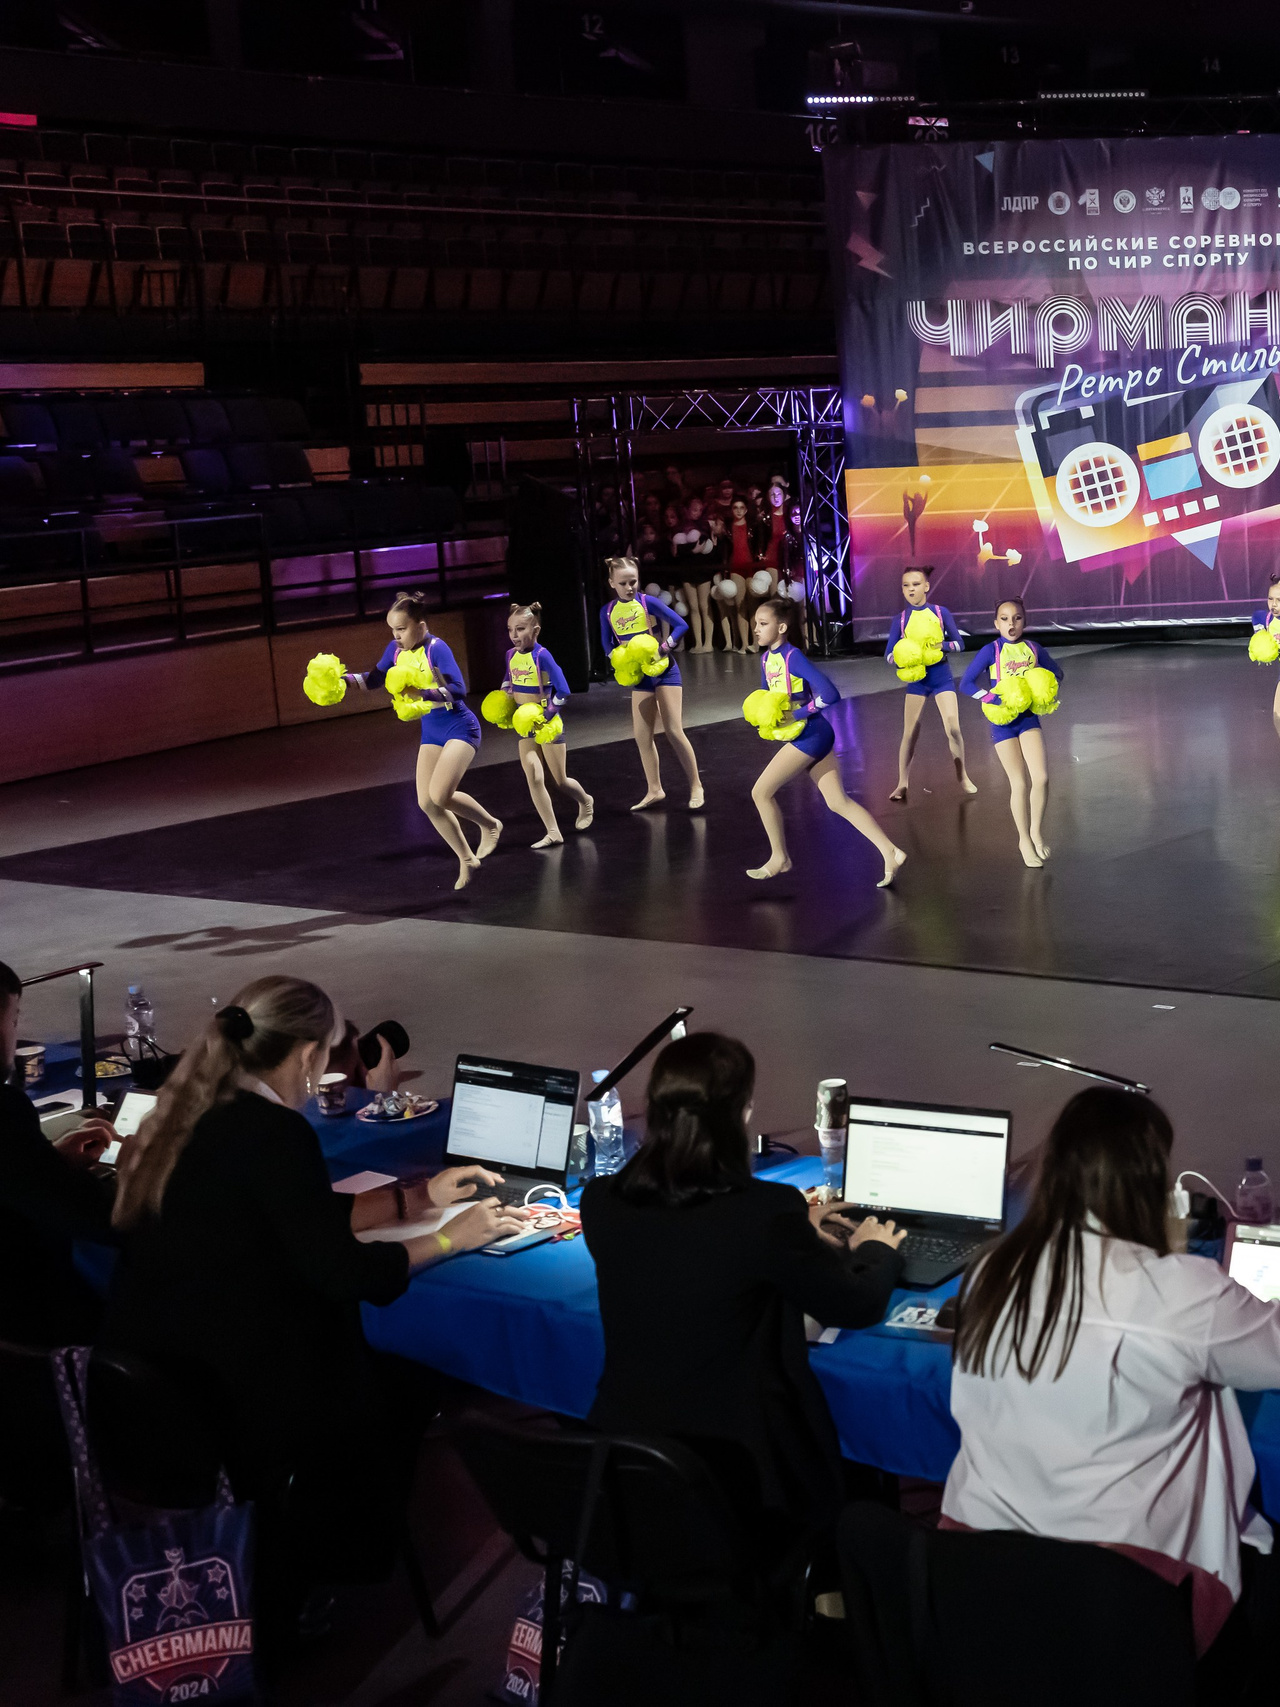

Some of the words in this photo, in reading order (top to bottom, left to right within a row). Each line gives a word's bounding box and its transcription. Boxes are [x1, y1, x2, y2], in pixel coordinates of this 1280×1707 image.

[1001, 196, 1039, 212] ЛДПР
[963, 234, 1159, 256] ВСЕРОССИЙСКИЕ
[1068, 255, 1098, 271] ПО
[1108, 253, 1152, 269] ЧИР
[1163, 252, 1250, 268] СПОРТУ
[1057, 364, 1162, 407] Ретро
[113, 1625, 252, 1677] CHEERMANIA
[169, 1678, 210, 1703] 2024
[506, 1673, 531, 1698] 2024
